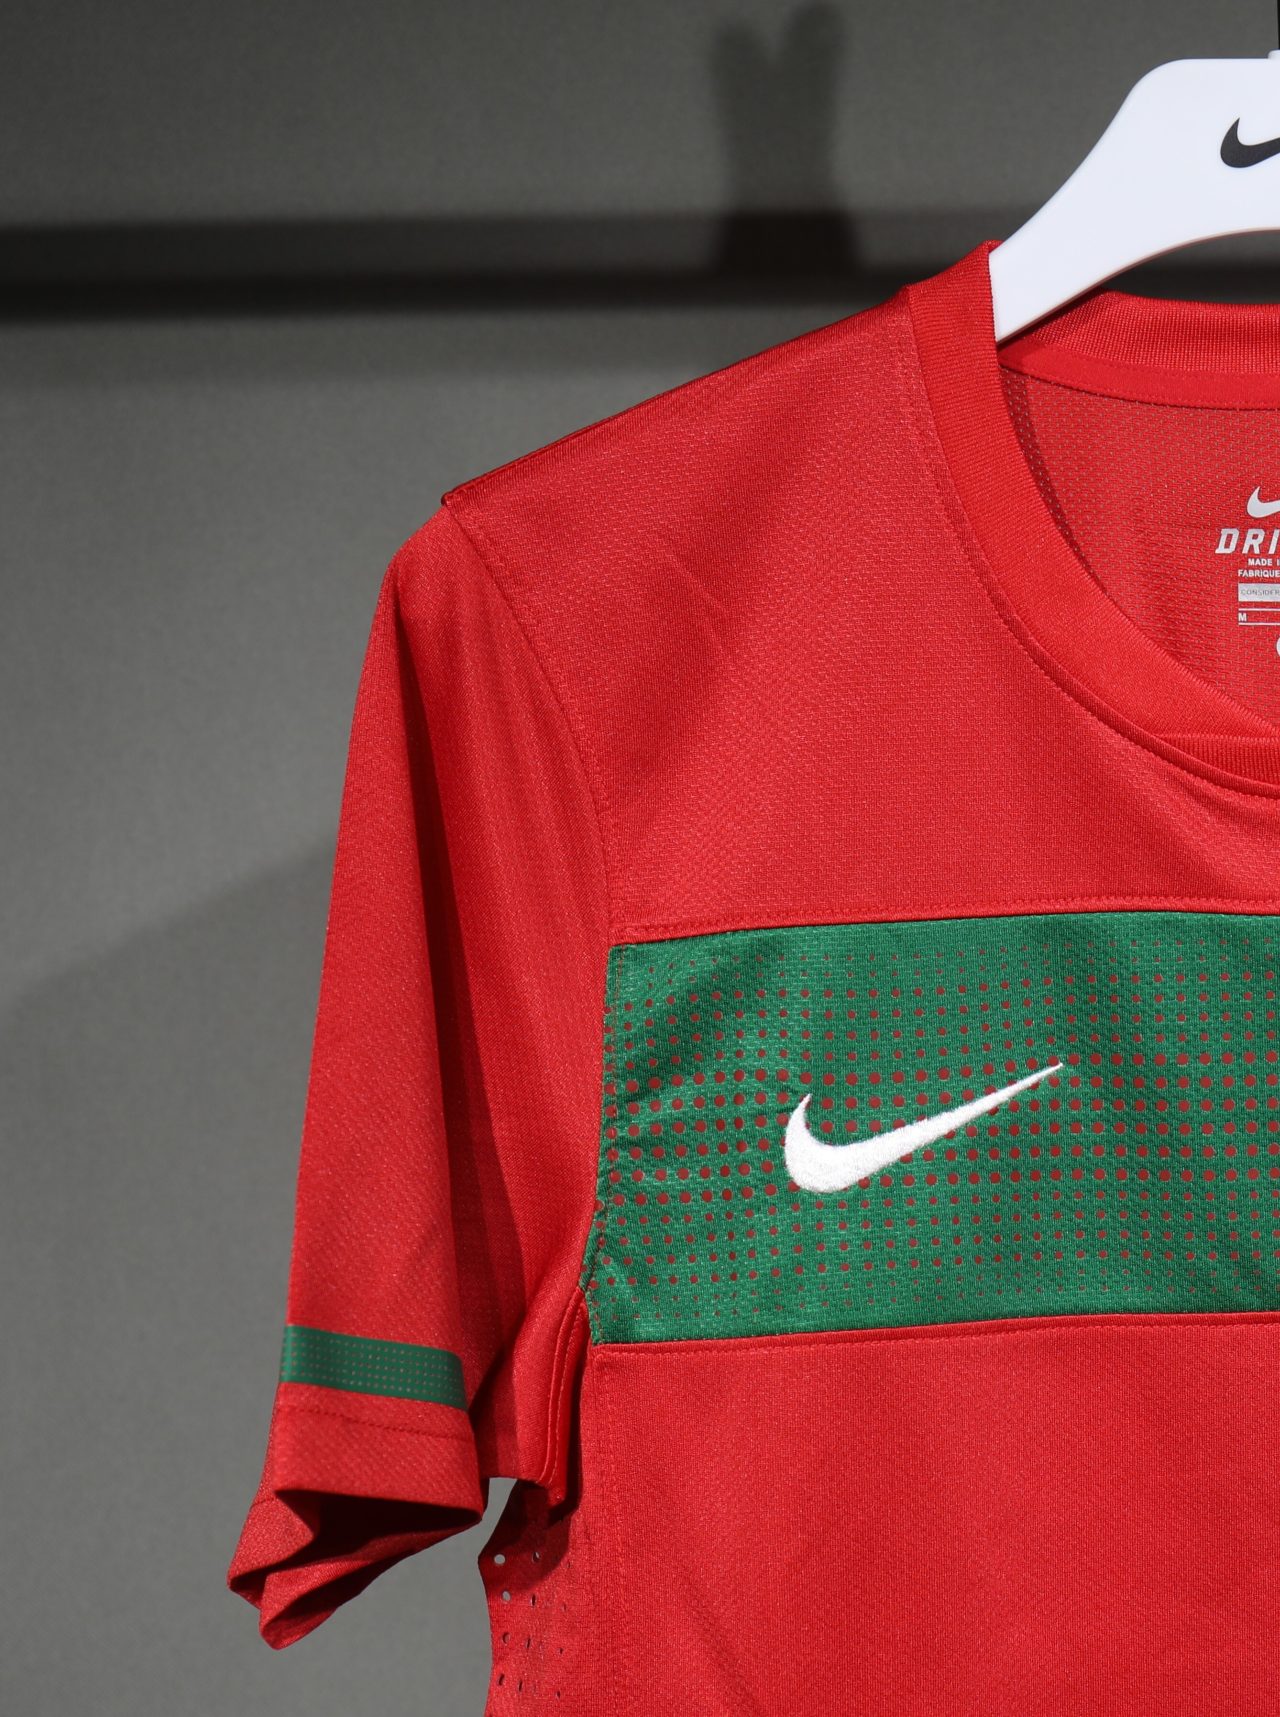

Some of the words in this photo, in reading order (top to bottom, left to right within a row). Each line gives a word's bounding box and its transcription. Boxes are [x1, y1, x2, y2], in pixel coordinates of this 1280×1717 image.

[1248, 559, 1272, 567] MADE
[1238, 570, 1280, 579] FABRIQUE
[1238, 612, 1248, 622] M
